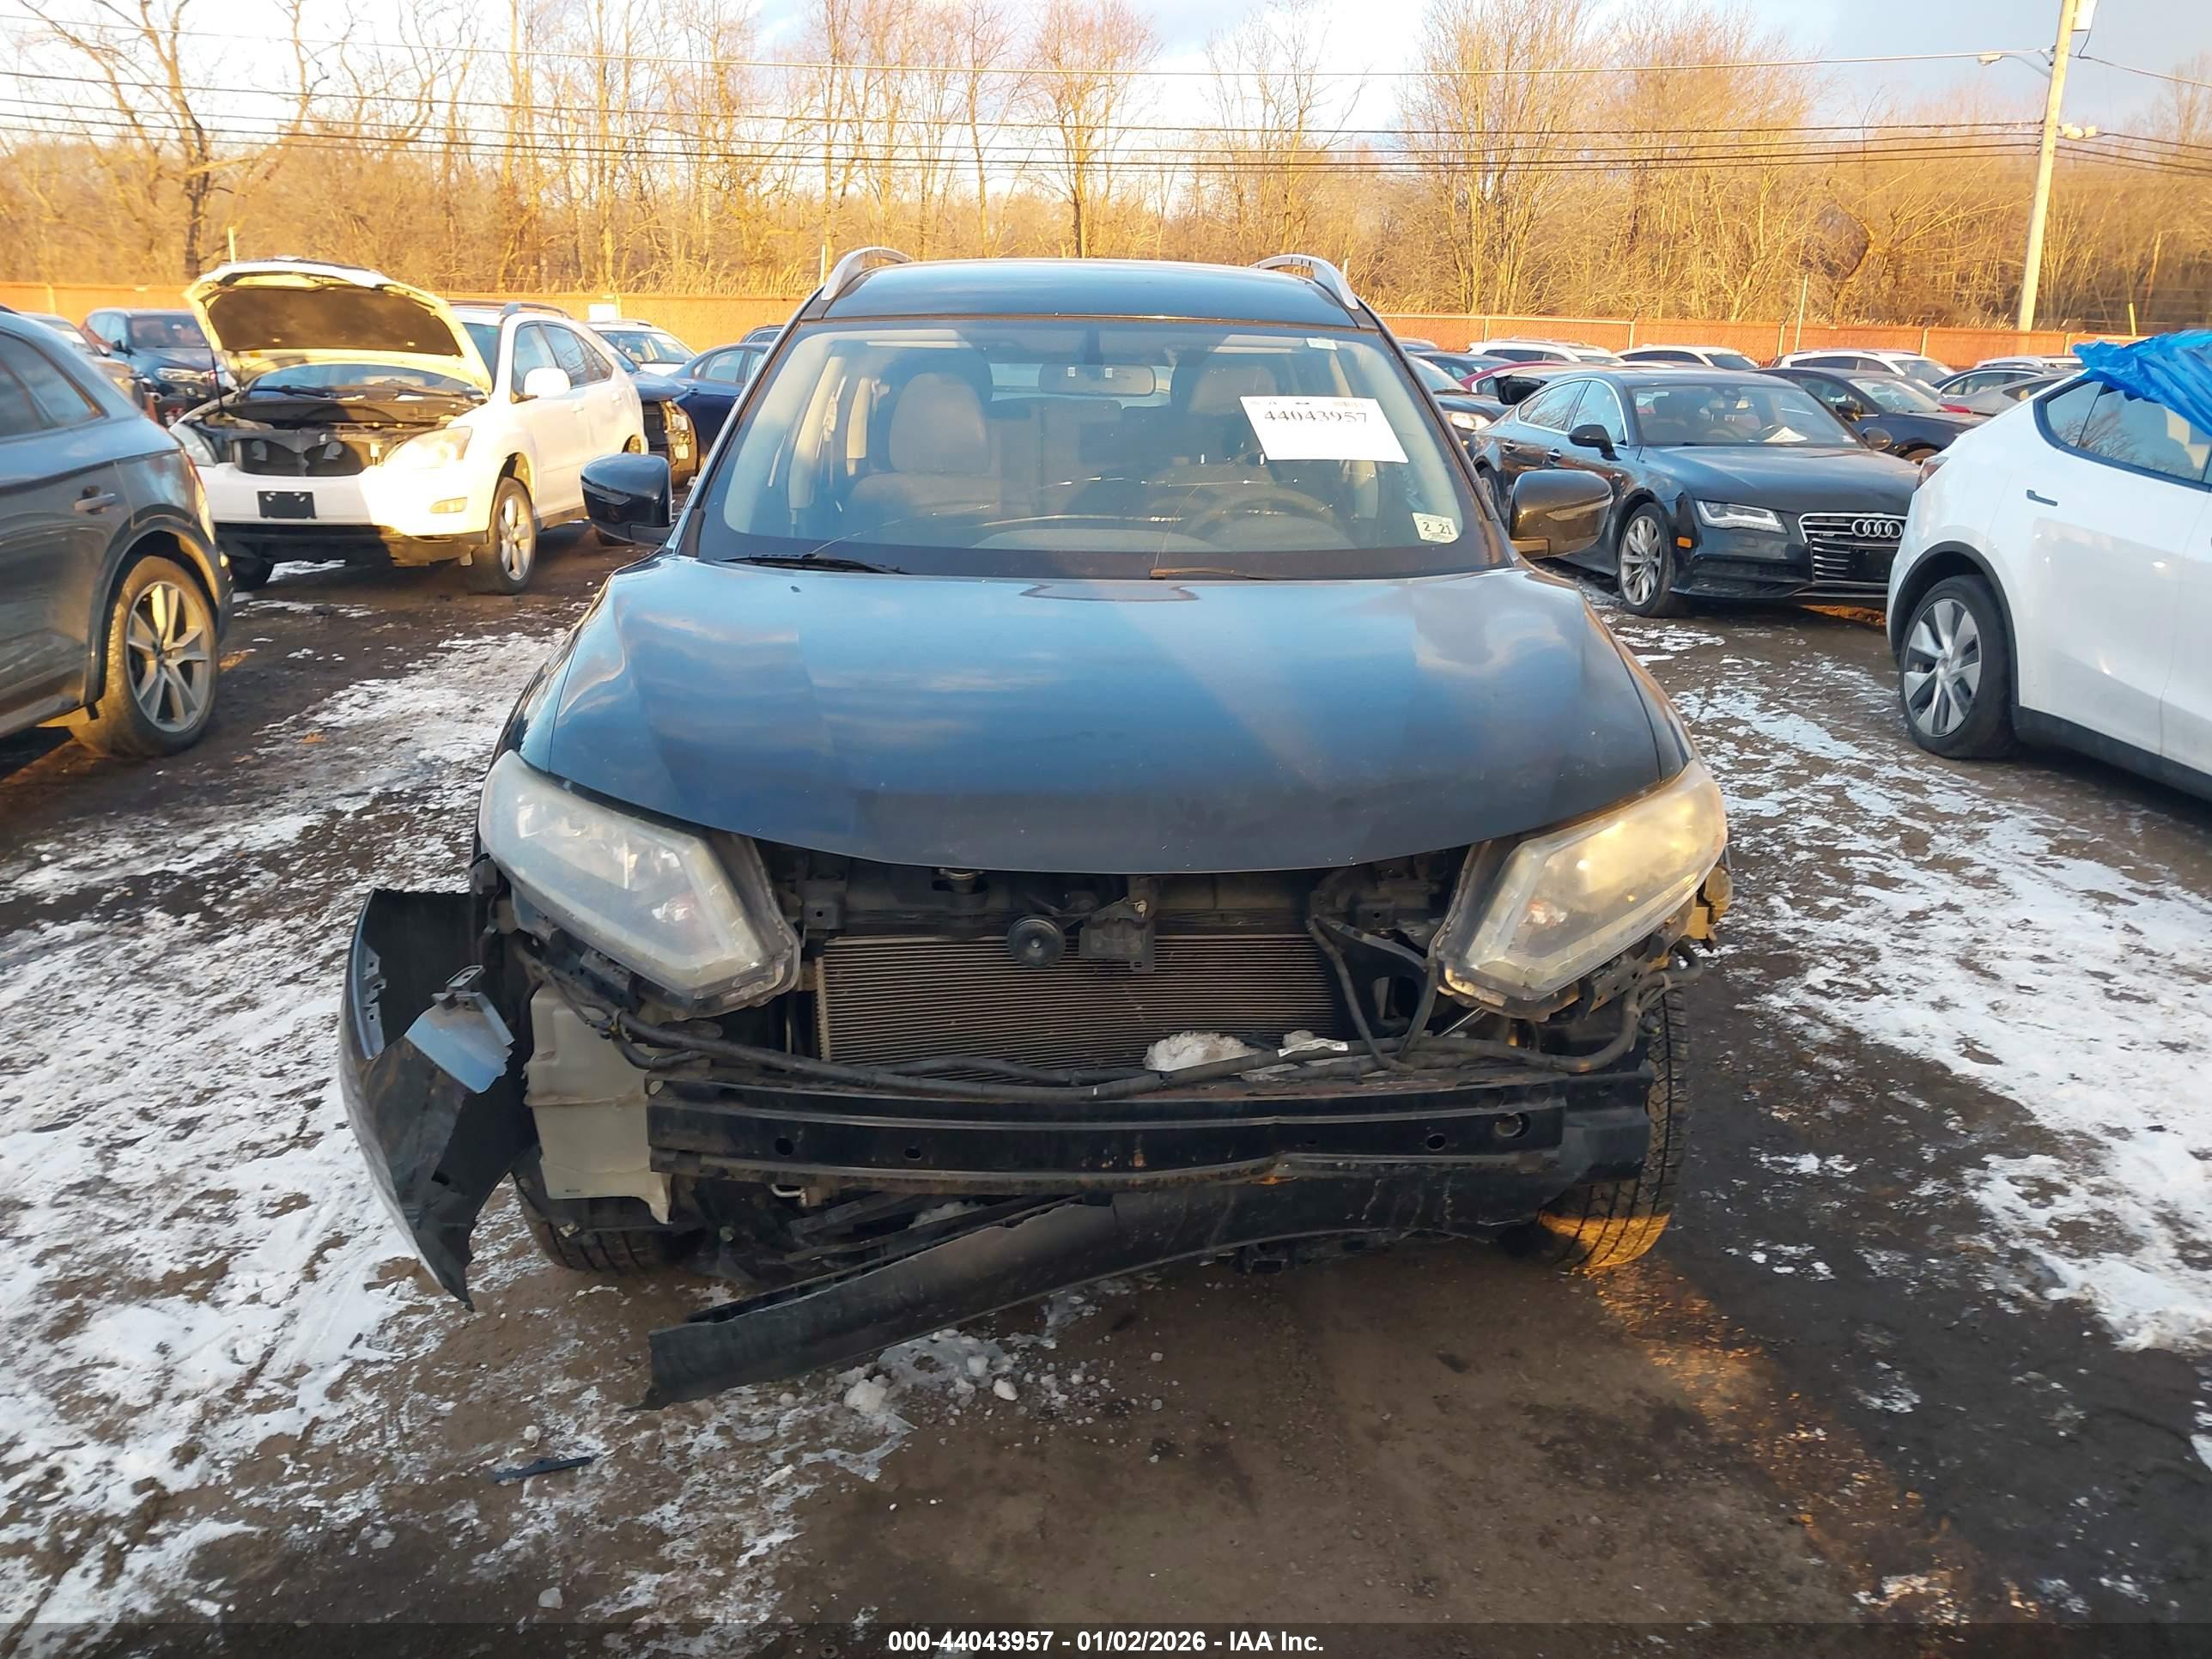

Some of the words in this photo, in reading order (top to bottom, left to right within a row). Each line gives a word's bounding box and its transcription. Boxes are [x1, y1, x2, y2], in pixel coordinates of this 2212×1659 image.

[1264, 410, 1367, 423] 44043957
[1423, 521, 1431, 532] 2
[1438, 523, 1453, 535] 21
